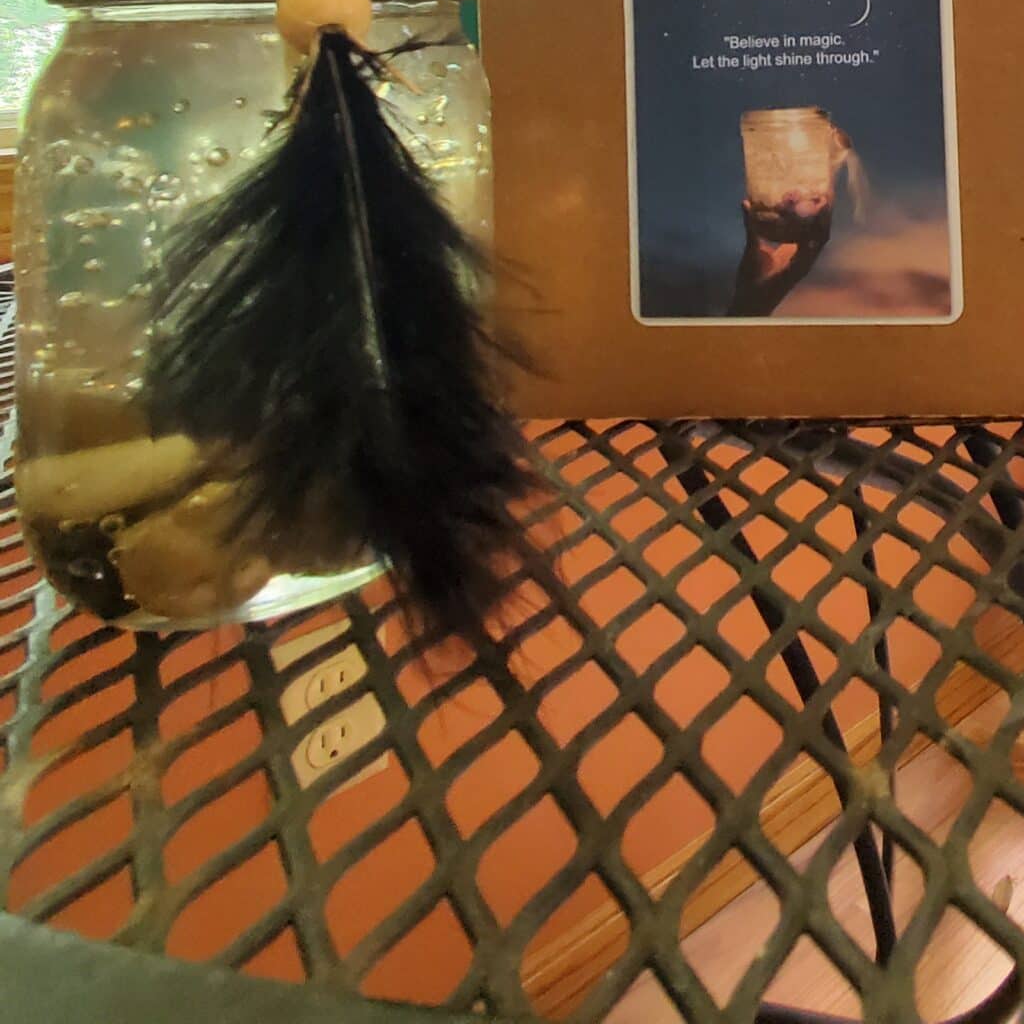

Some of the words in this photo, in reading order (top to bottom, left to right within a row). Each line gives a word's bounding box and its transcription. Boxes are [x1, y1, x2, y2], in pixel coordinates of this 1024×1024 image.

[724, 35, 779, 49] "Believe
[784, 34, 795, 46] in
[692, 55, 714, 69] Let
[718, 54, 739, 67] the
[743, 53, 772, 70] light
[775, 52, 812, 66] shine
[816, 50, 879, 66] through."
